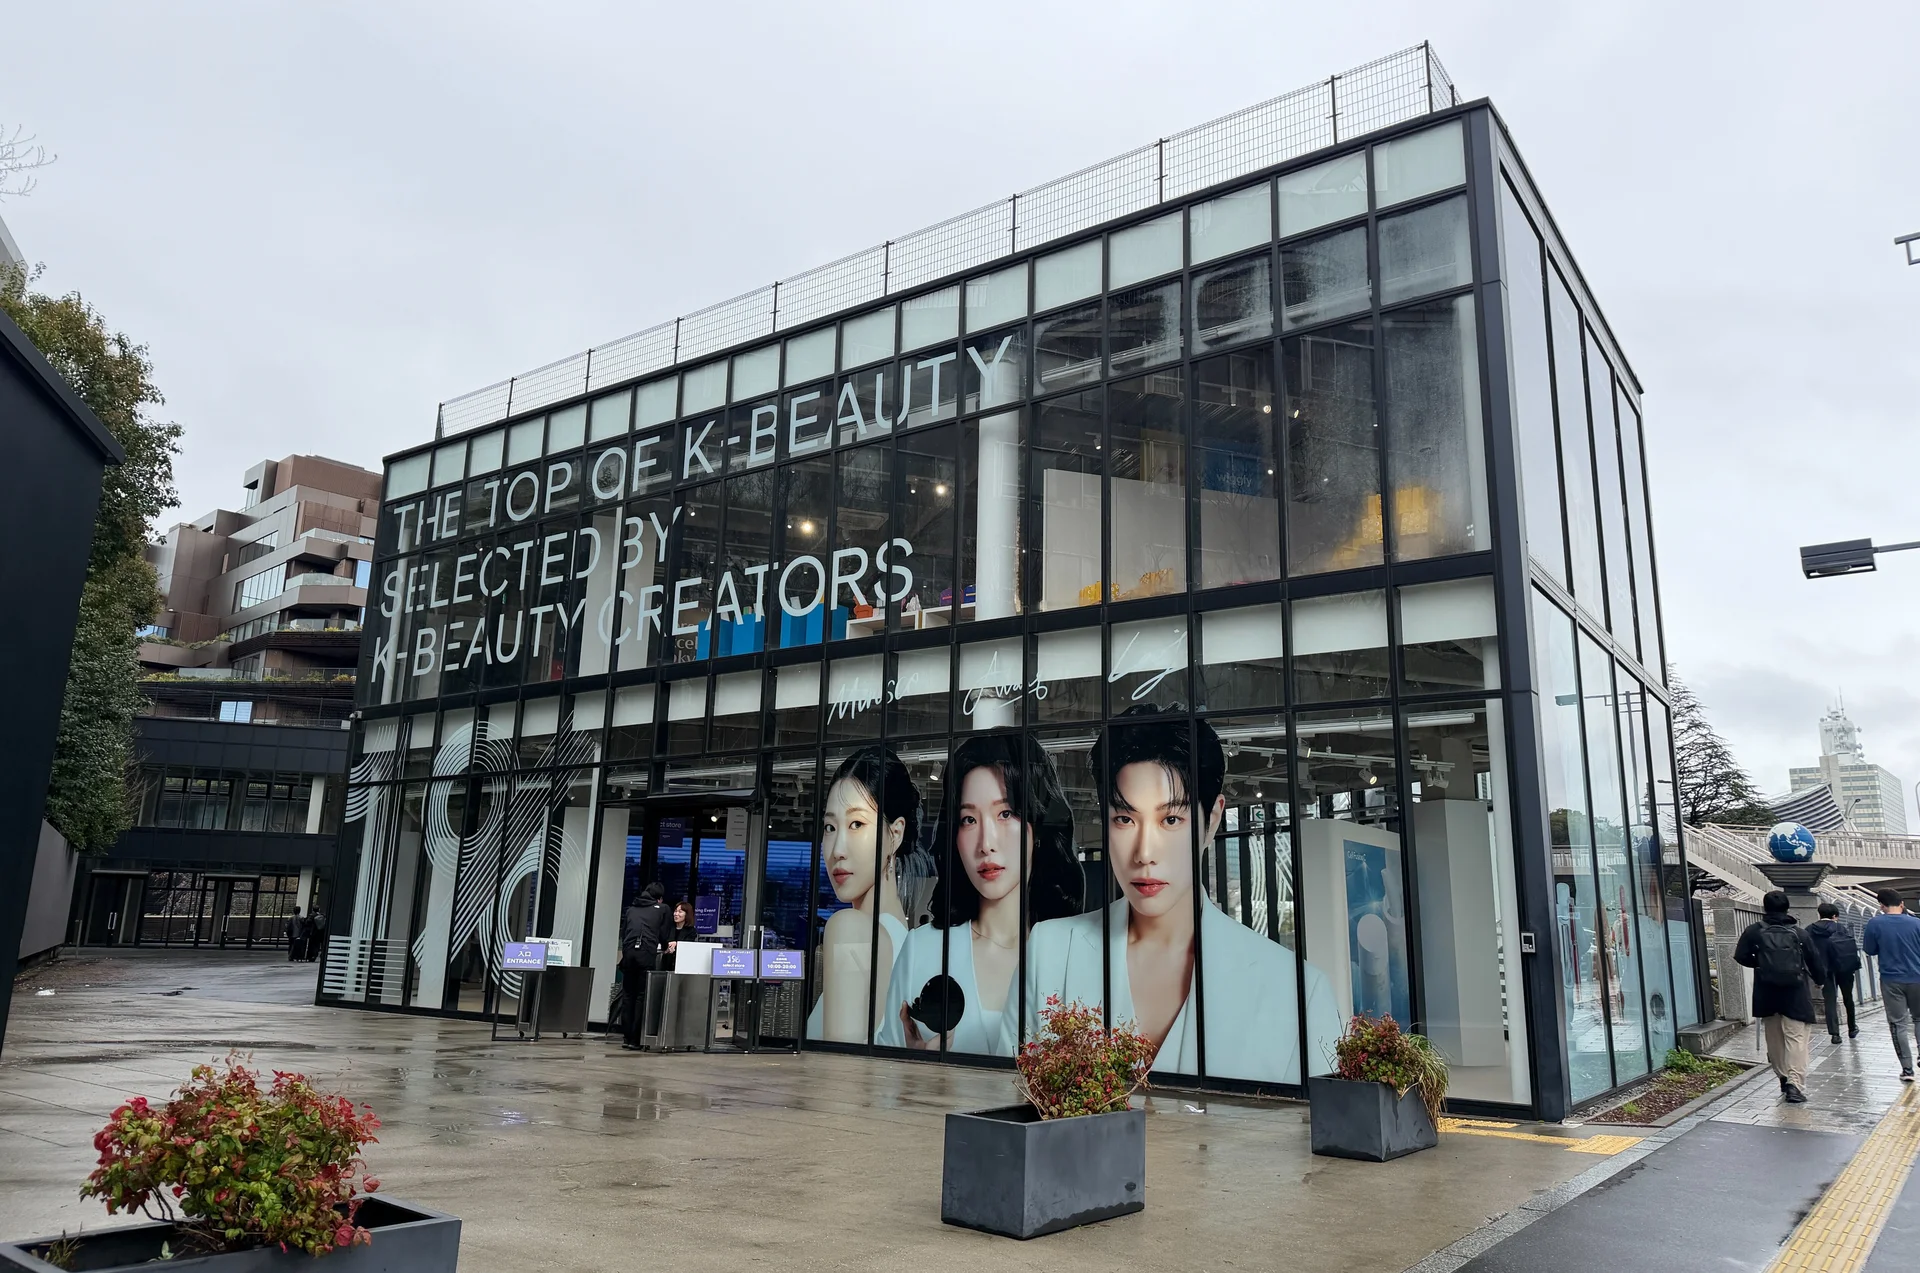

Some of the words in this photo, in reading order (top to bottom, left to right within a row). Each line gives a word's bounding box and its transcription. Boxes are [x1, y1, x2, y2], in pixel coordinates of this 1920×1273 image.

[393, 489, 462, 552] THE
[483, 461, 573, 527] TOP
[590, 435, 661, 500] OF
[682, 335, 1012, 480] K-BEAUTY
[371, 597, 587, 684] K-BEAUTY
[598, 537, 915, 647] CREATORS
[381, 525, 600, 619] SELECTED
[620, 506, 683, 570] BY
